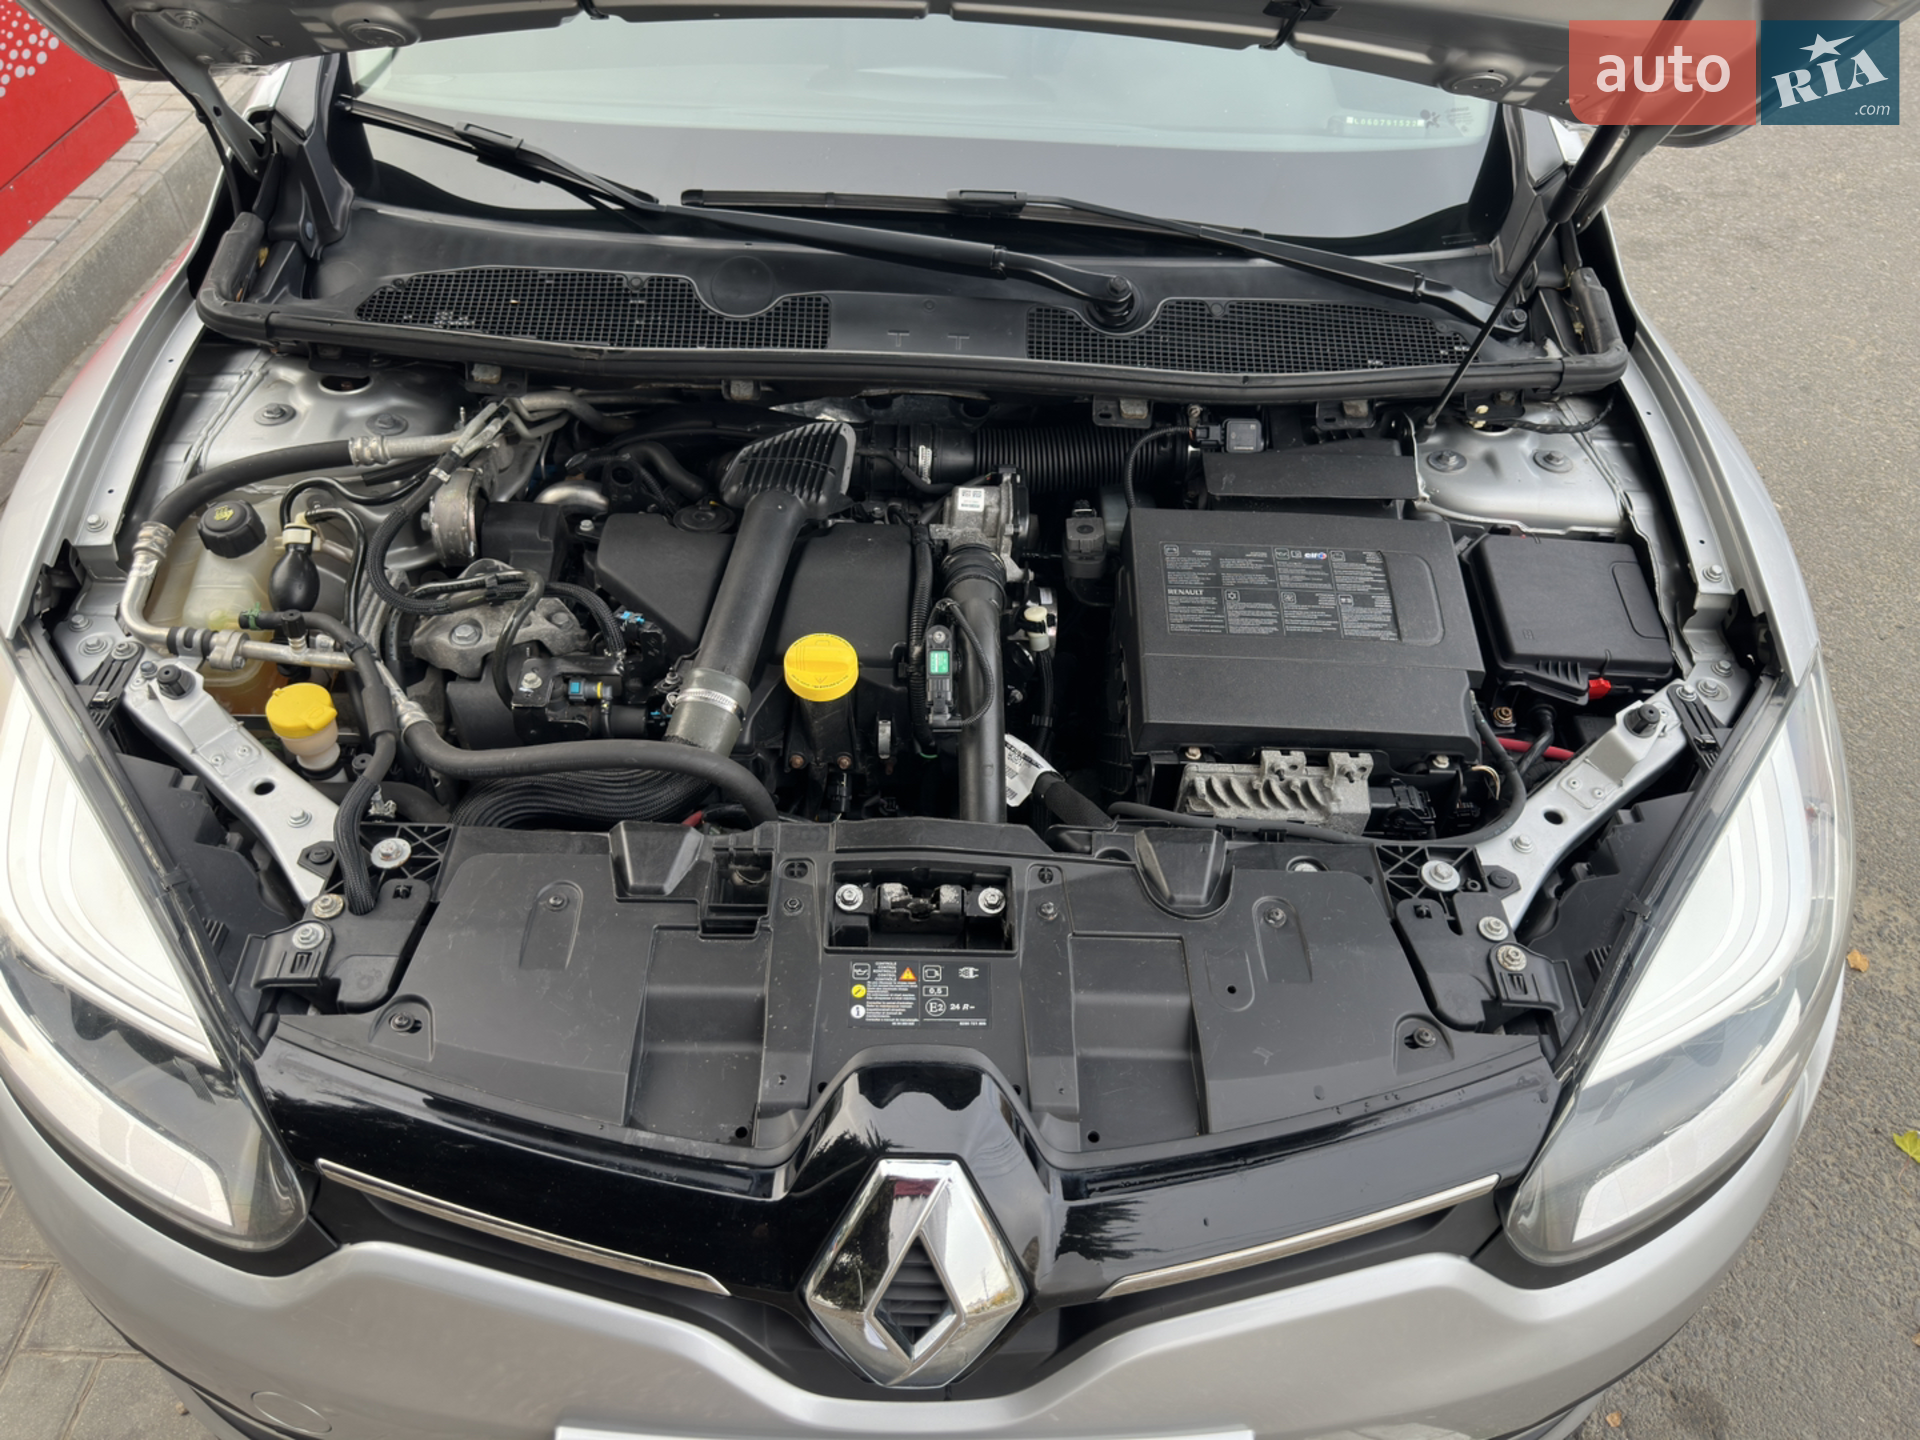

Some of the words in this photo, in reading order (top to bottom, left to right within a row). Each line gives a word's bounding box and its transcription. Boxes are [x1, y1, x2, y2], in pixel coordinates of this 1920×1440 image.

[1168, 588, 1204, 596] RENAULT
[929, 1002, 944, 1013] E2
[949, 1003, 961, 1011] 24
